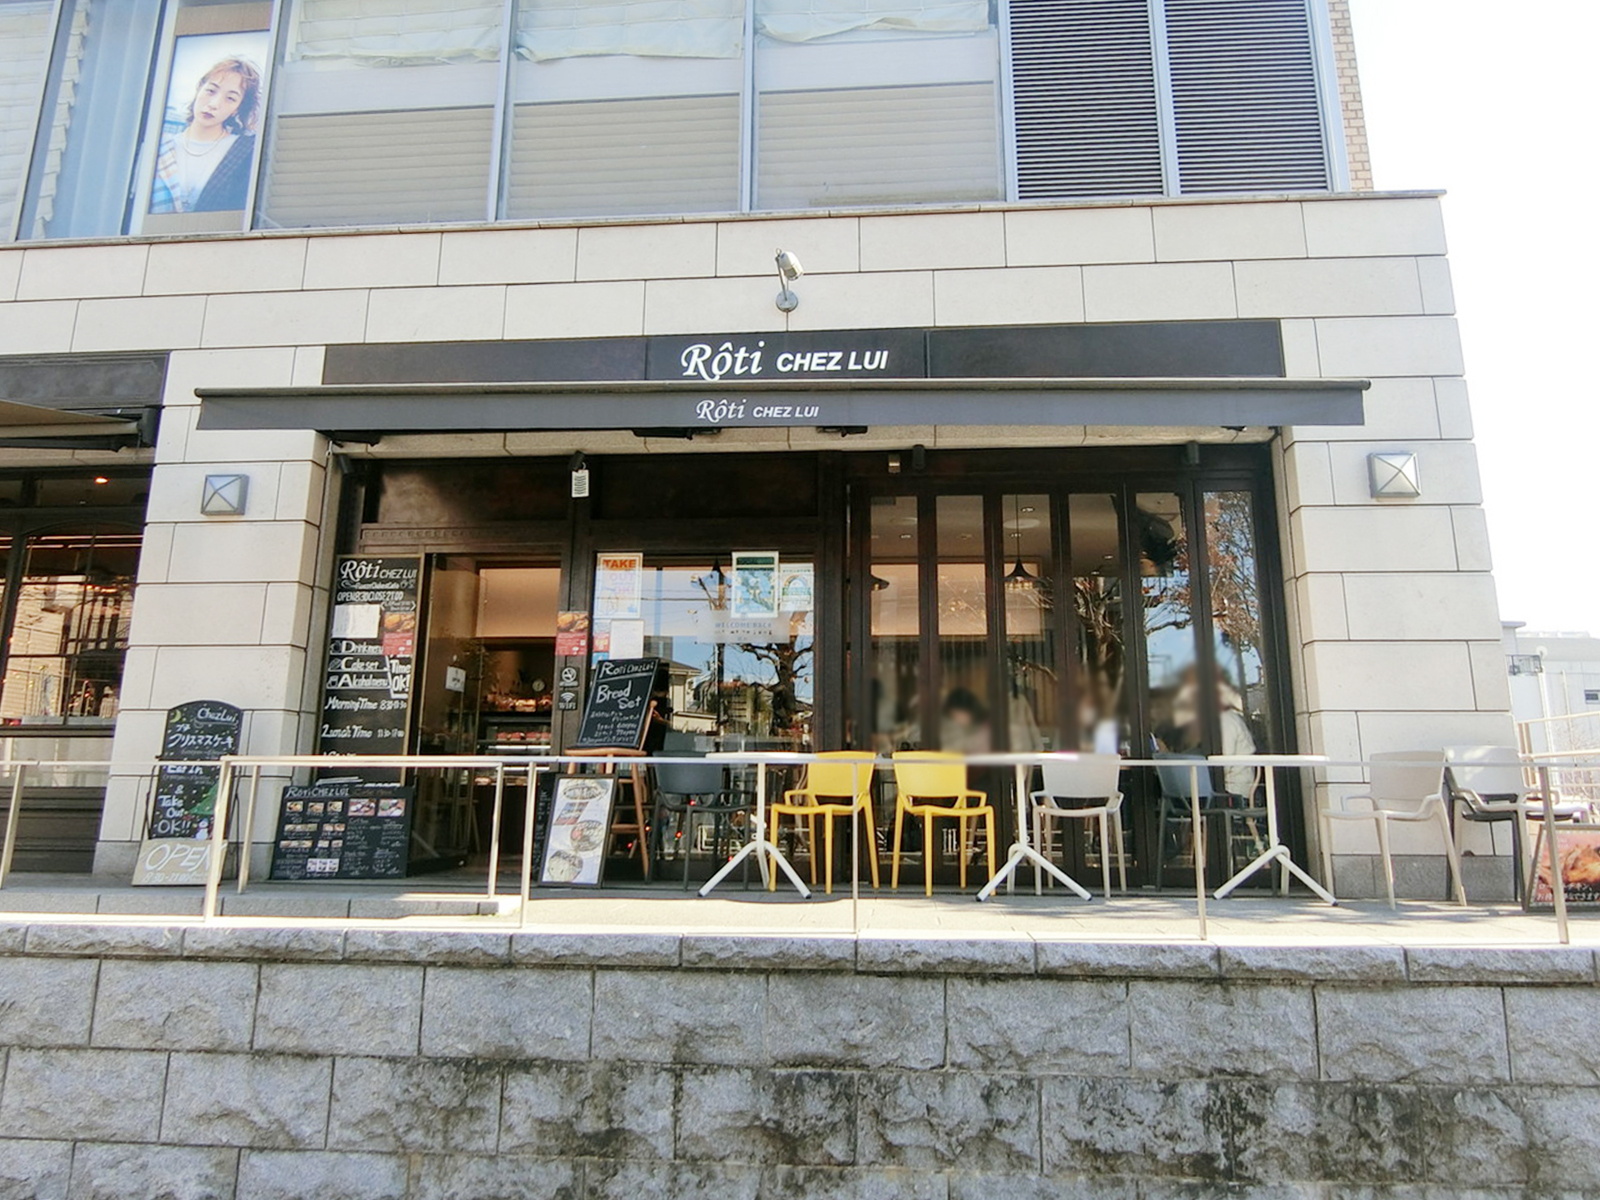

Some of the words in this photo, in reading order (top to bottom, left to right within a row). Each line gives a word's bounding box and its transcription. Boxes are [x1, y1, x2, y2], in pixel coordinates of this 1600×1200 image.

[681, 340, 765, 381] Rôti
[776, 352, 842, 371] CHEZ
[848, 350, 889, 370] LUI
[696, 399, 747, 423] Rôti
[752, 406, 792, 418] CHEZ
[795, 406, 819, 418] LUI
[340, 559, 383, 582] Rôti
[380, 569, 403, 579] CHEZ
[403, 569, 418, 579] LUI
[603, 559, 636, 568] TAKE
[596, 680, 632, 704] Bread
[618, 696, 642, 709] Set
[168, 733, 235, 749] クリスマスケーキ
[159, 795, 184, 807] Take
[166, 808, 184, 818] Out
[157, 819, 191, 834] OK!!
